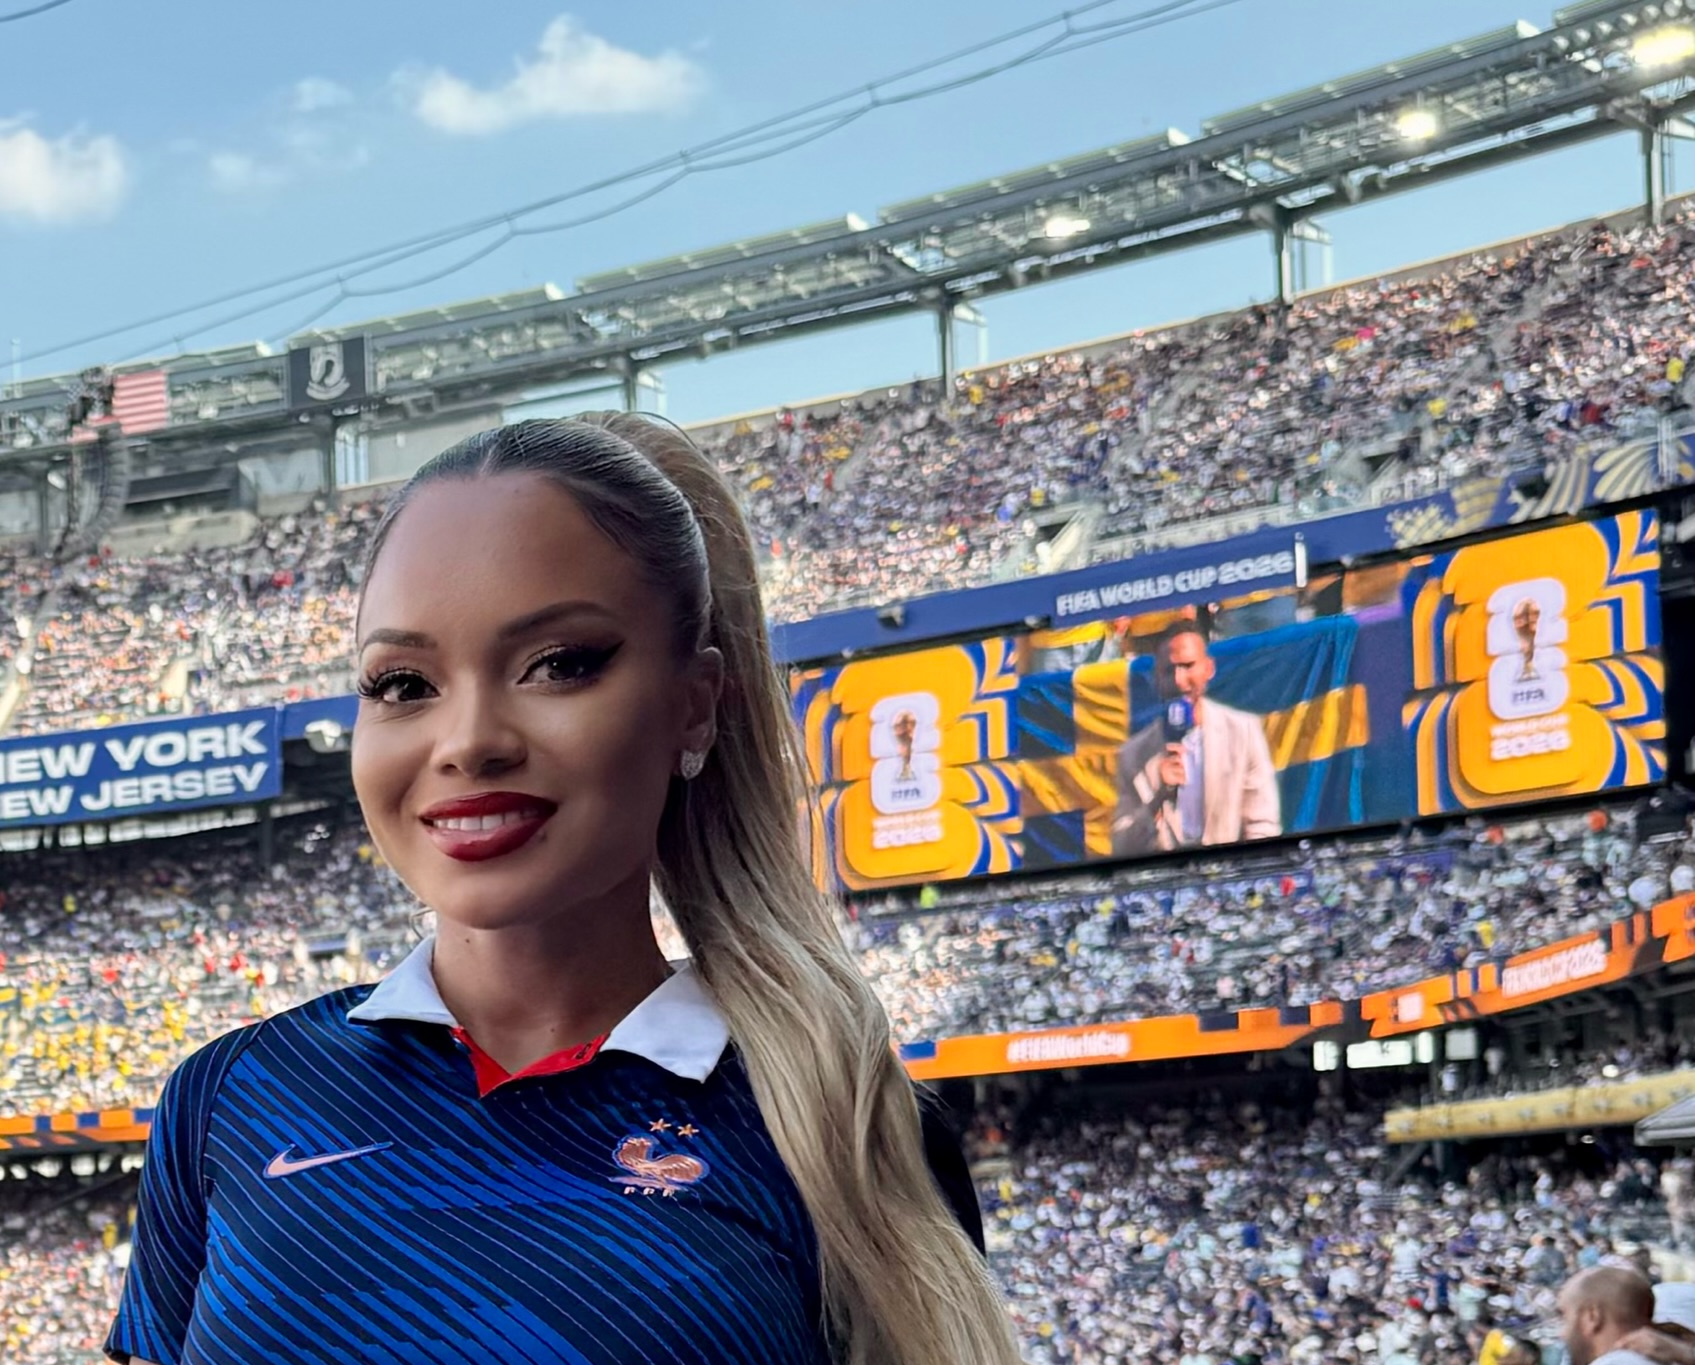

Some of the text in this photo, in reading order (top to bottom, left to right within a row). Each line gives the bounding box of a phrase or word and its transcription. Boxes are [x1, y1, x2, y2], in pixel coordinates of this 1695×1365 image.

[1057, 551, 1295, 616] FIFA WORLD CUP 2026
[106, 720, 267, 771] YORK
[80, 762, 268, 811] JERSEY
